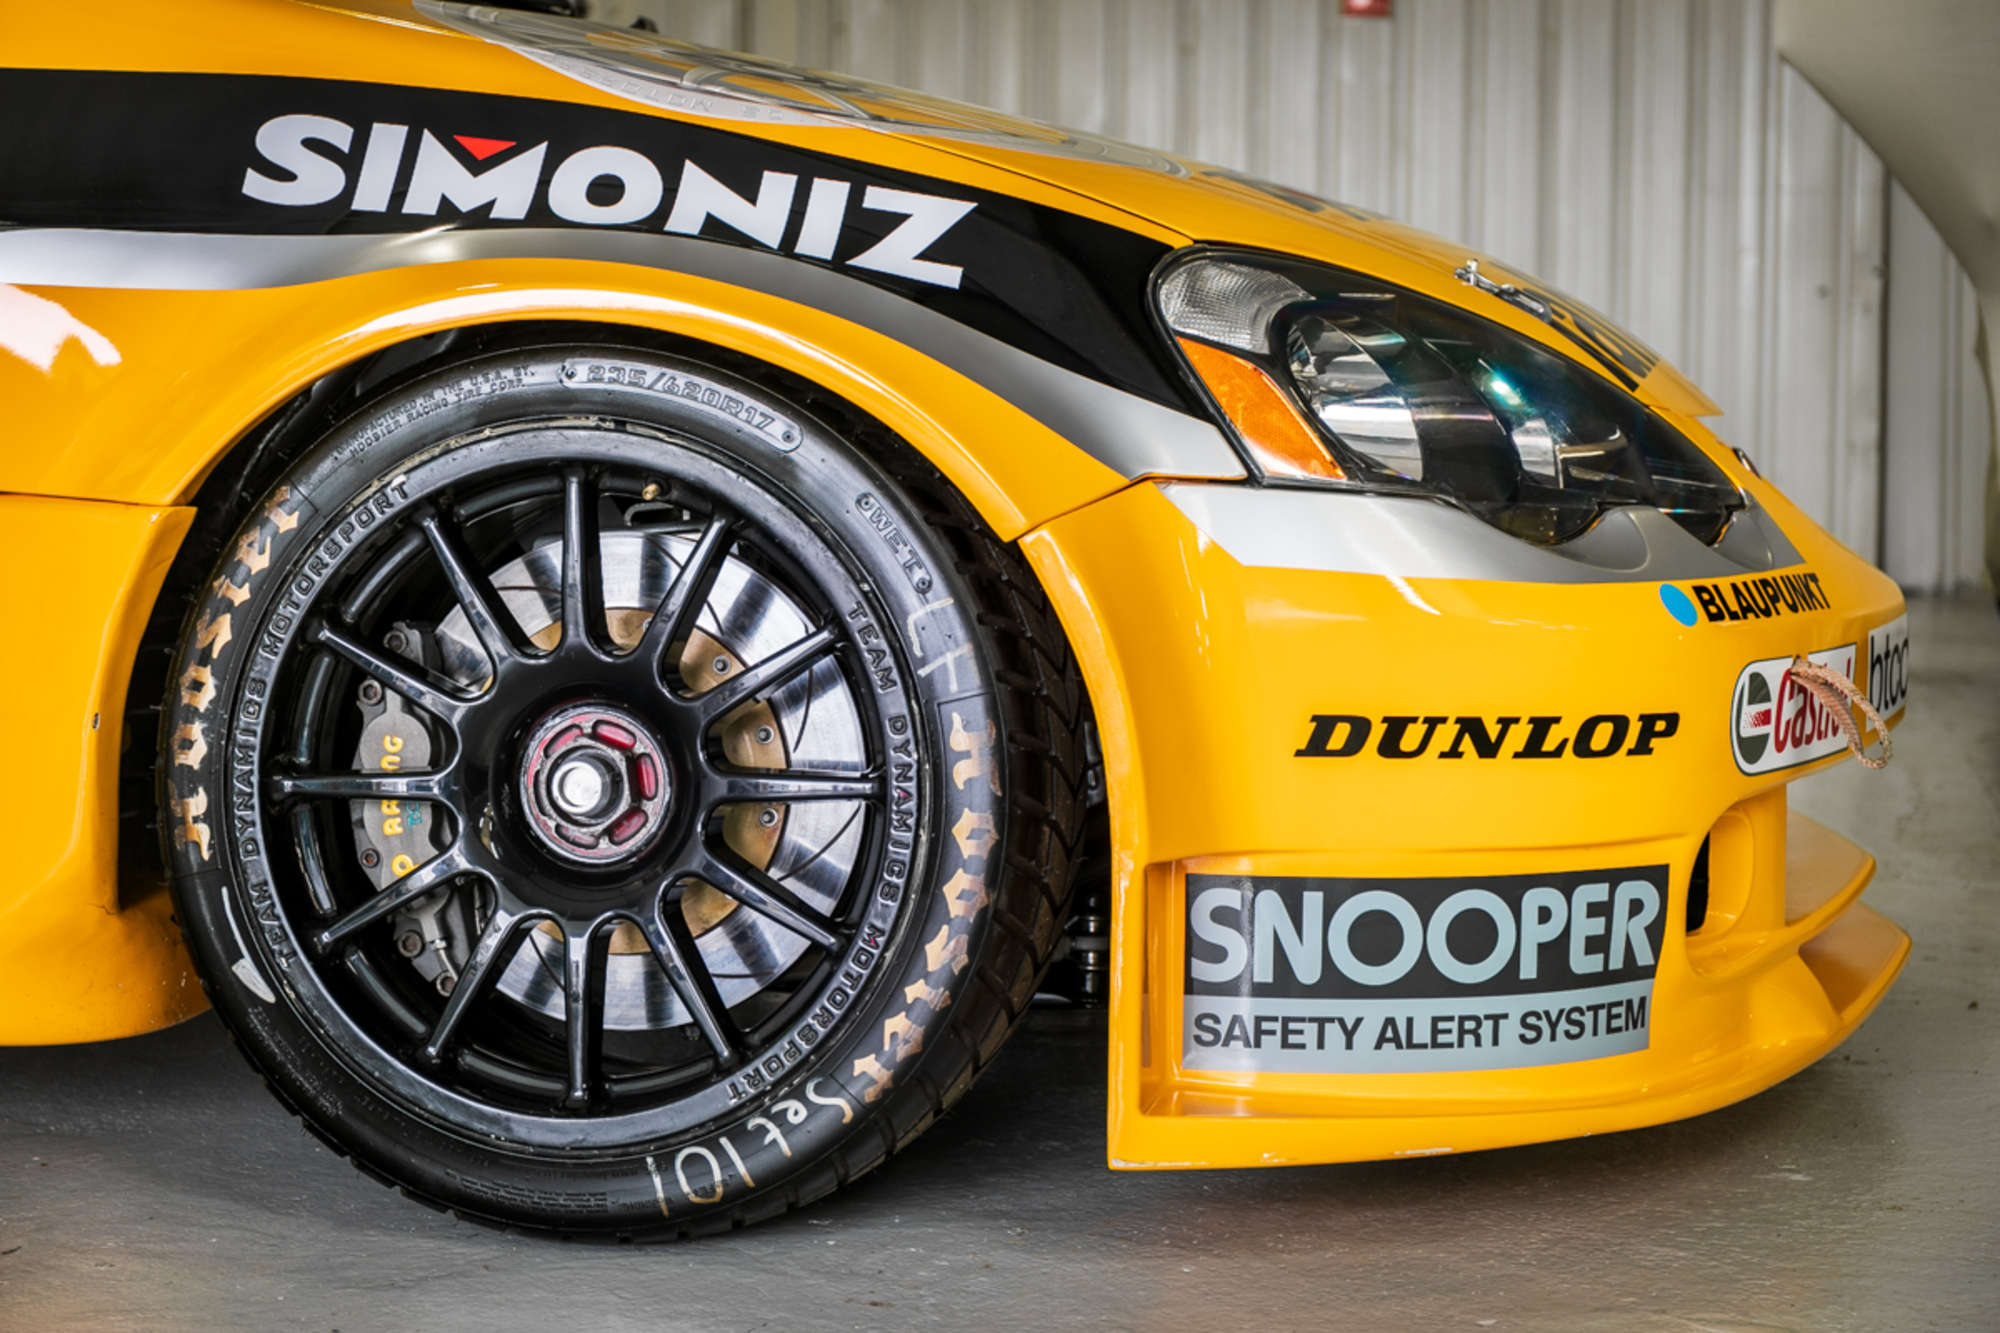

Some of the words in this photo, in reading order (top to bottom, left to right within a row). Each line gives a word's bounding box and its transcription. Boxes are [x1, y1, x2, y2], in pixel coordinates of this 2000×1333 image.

[241, 113, 978, 289] SIMONIZ
[586, 364, 776, 431] 235/620R17
[260, 481, 409, 661] MOTORSPORT
[868, 503, 923, 572] WET
[1691, 572, 1831, 622] BLAUPUNKT
[848, 599, 898, 695] TEAM
[1868, 632, 1909, 713] btcc
[233, 677, 267, 861] DYNAMICS
[1293, 711, 1680, 759] DUNLOP
[877, 714, 915, 905] DYNAMICS
[252, 883, 298, 971] TEAM
[1189, 880, 1661, 986] SNOOPER
[726, 922, 886, 1104] MOTORSPORT
[1192, 1012, 1364, 1050] SAFETY
[1373, 1012, 1509, 1050] ALERT
[1518, 995, 1648, 1044] SYSTEM
[747, 1076, 854, 1159] Set
